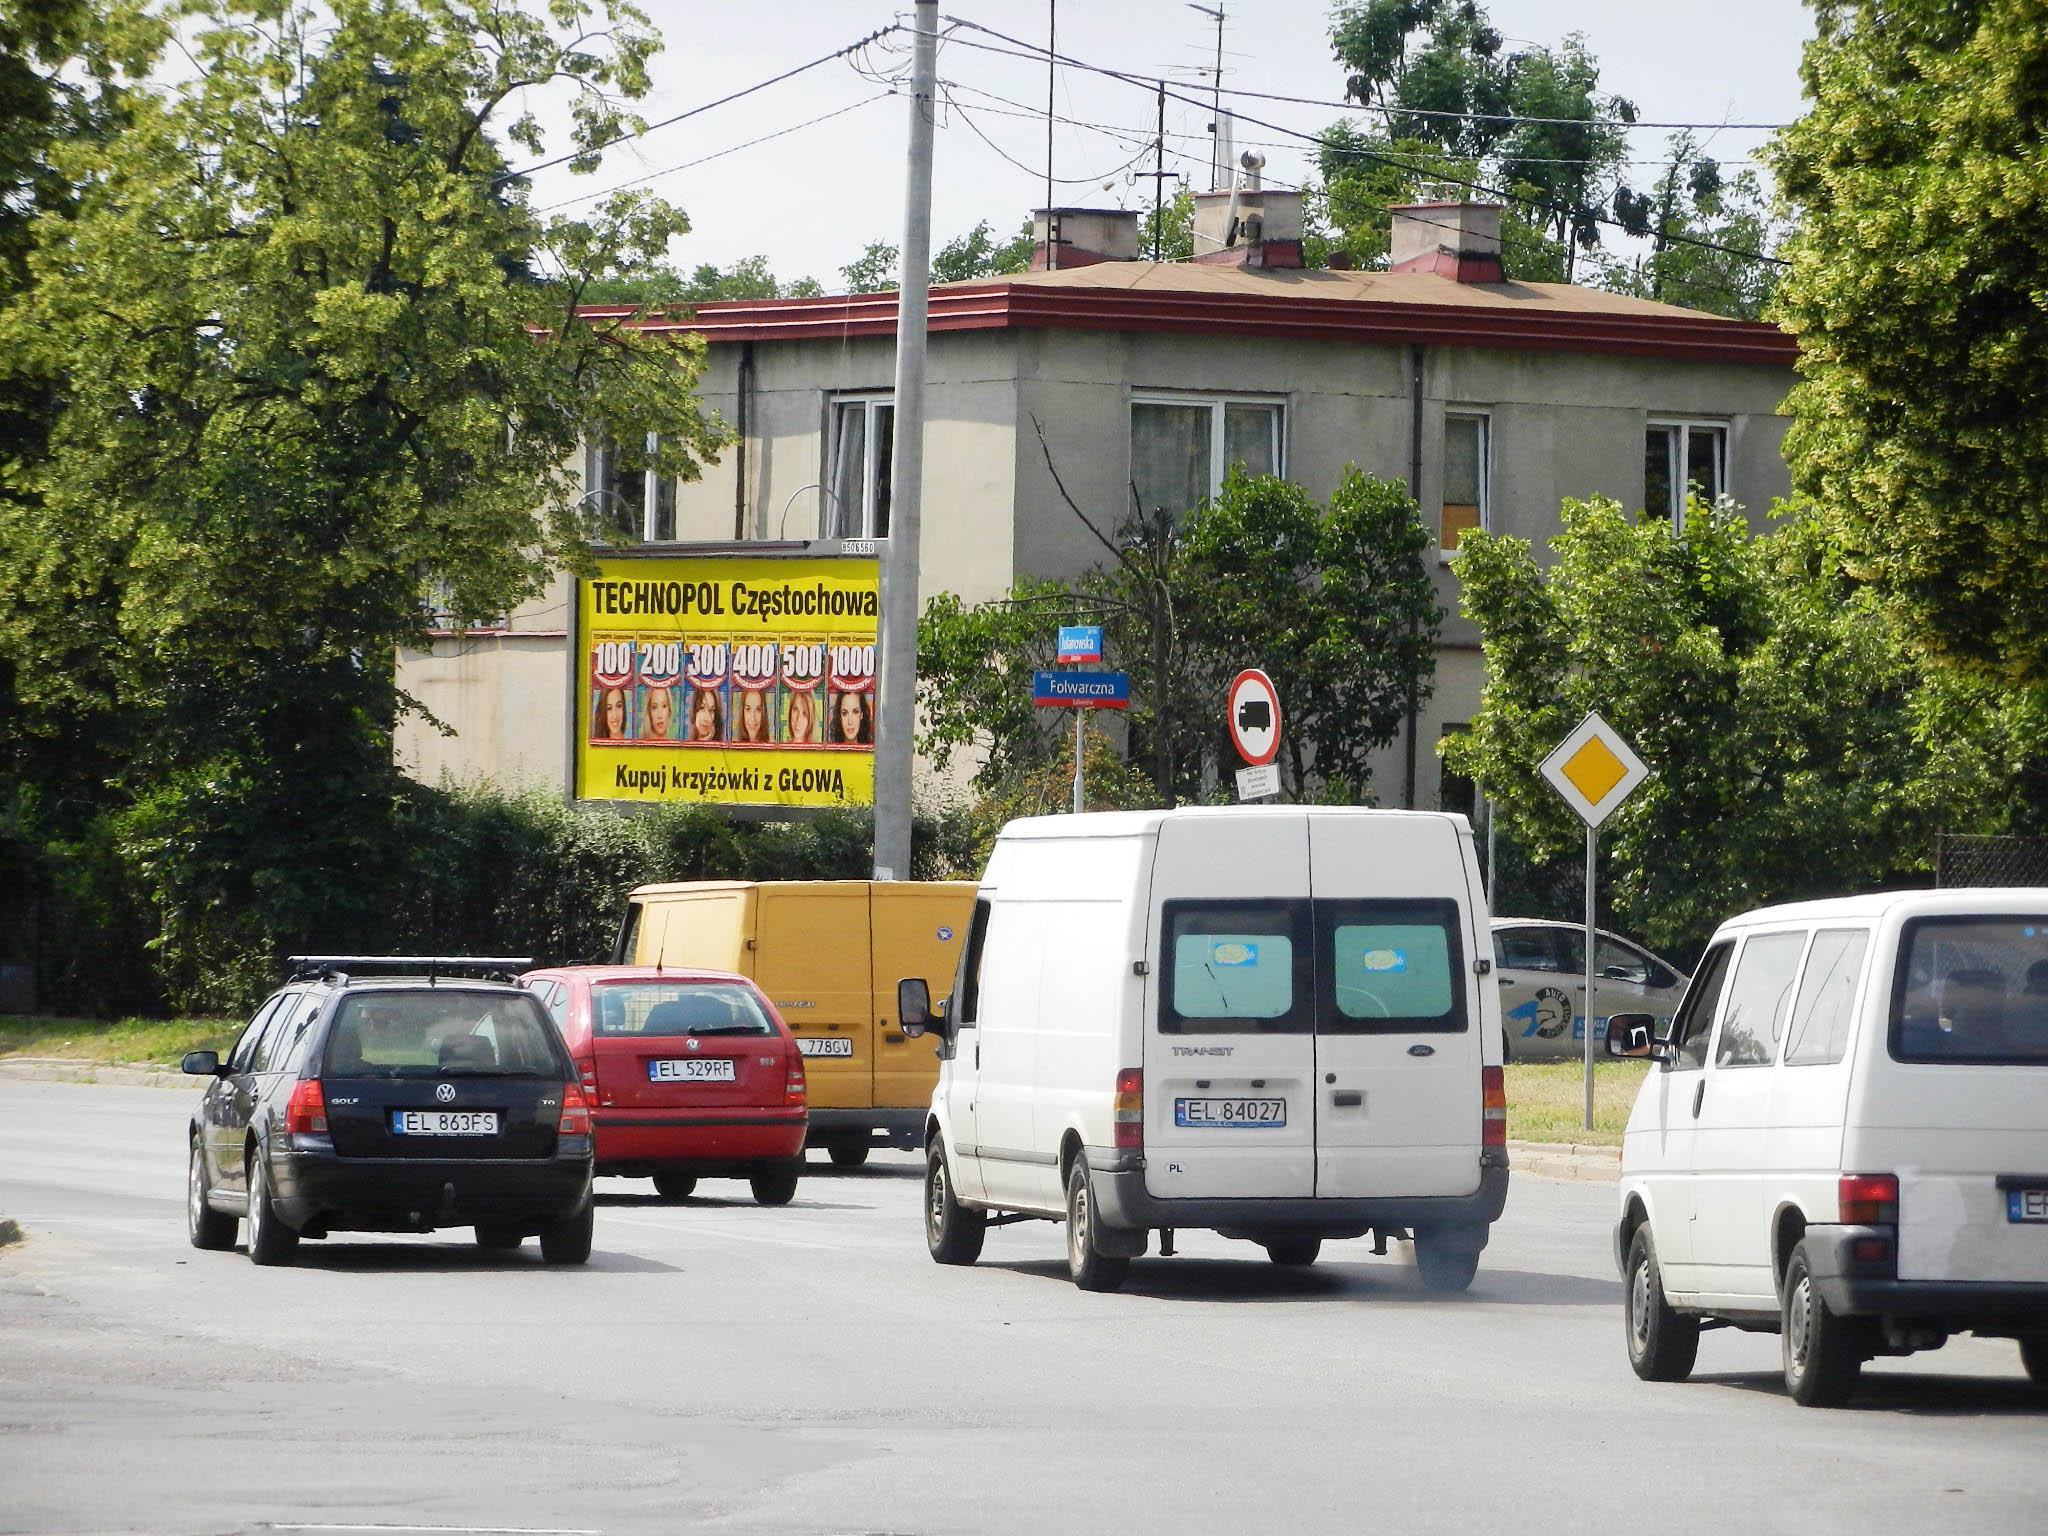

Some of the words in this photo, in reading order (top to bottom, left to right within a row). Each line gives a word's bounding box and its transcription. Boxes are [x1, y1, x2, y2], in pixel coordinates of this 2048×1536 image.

[592, 581, 725, 615] TECHNOPOL
[731, 582, 878, 622] Częstochowa
[596, 642, 630, 675] 100
[641, 643, 680, 675] 200
[687, 643, 726, 676] 300
[733, 644, 775, 677] 400
[782, 644, 821, 677] 500
[830, 645, 875, 676] 1000
[1050, 680, 1115, 695] Folwarczna
[615, 764, 667, 794] Kupuj
[672, 766, 759, 796] krzyżówki
[763, 774, 773, 791] z
[778, 767, 844, 799] GŁOWĄ
[1544, 987, 1567, 1002] AUTO
[808, 1040, 849, 1054] 778GV
[1172, 1047, 1234, 1056] TRANSIT
[658, 1061, 681, 1077] EL
[686, 1061, 732, 1077] 529RF
[331, 1097, 359, 1105] GOLF
[1188, 1102, 1216, 1121] EL
[1223, 1102, 1281, 1121] 84027
[406, 1114, 431, 1131] EL
[439, 1114, 494, 1132] 863FS
[1168, 1163, 1183, 1173] PL
